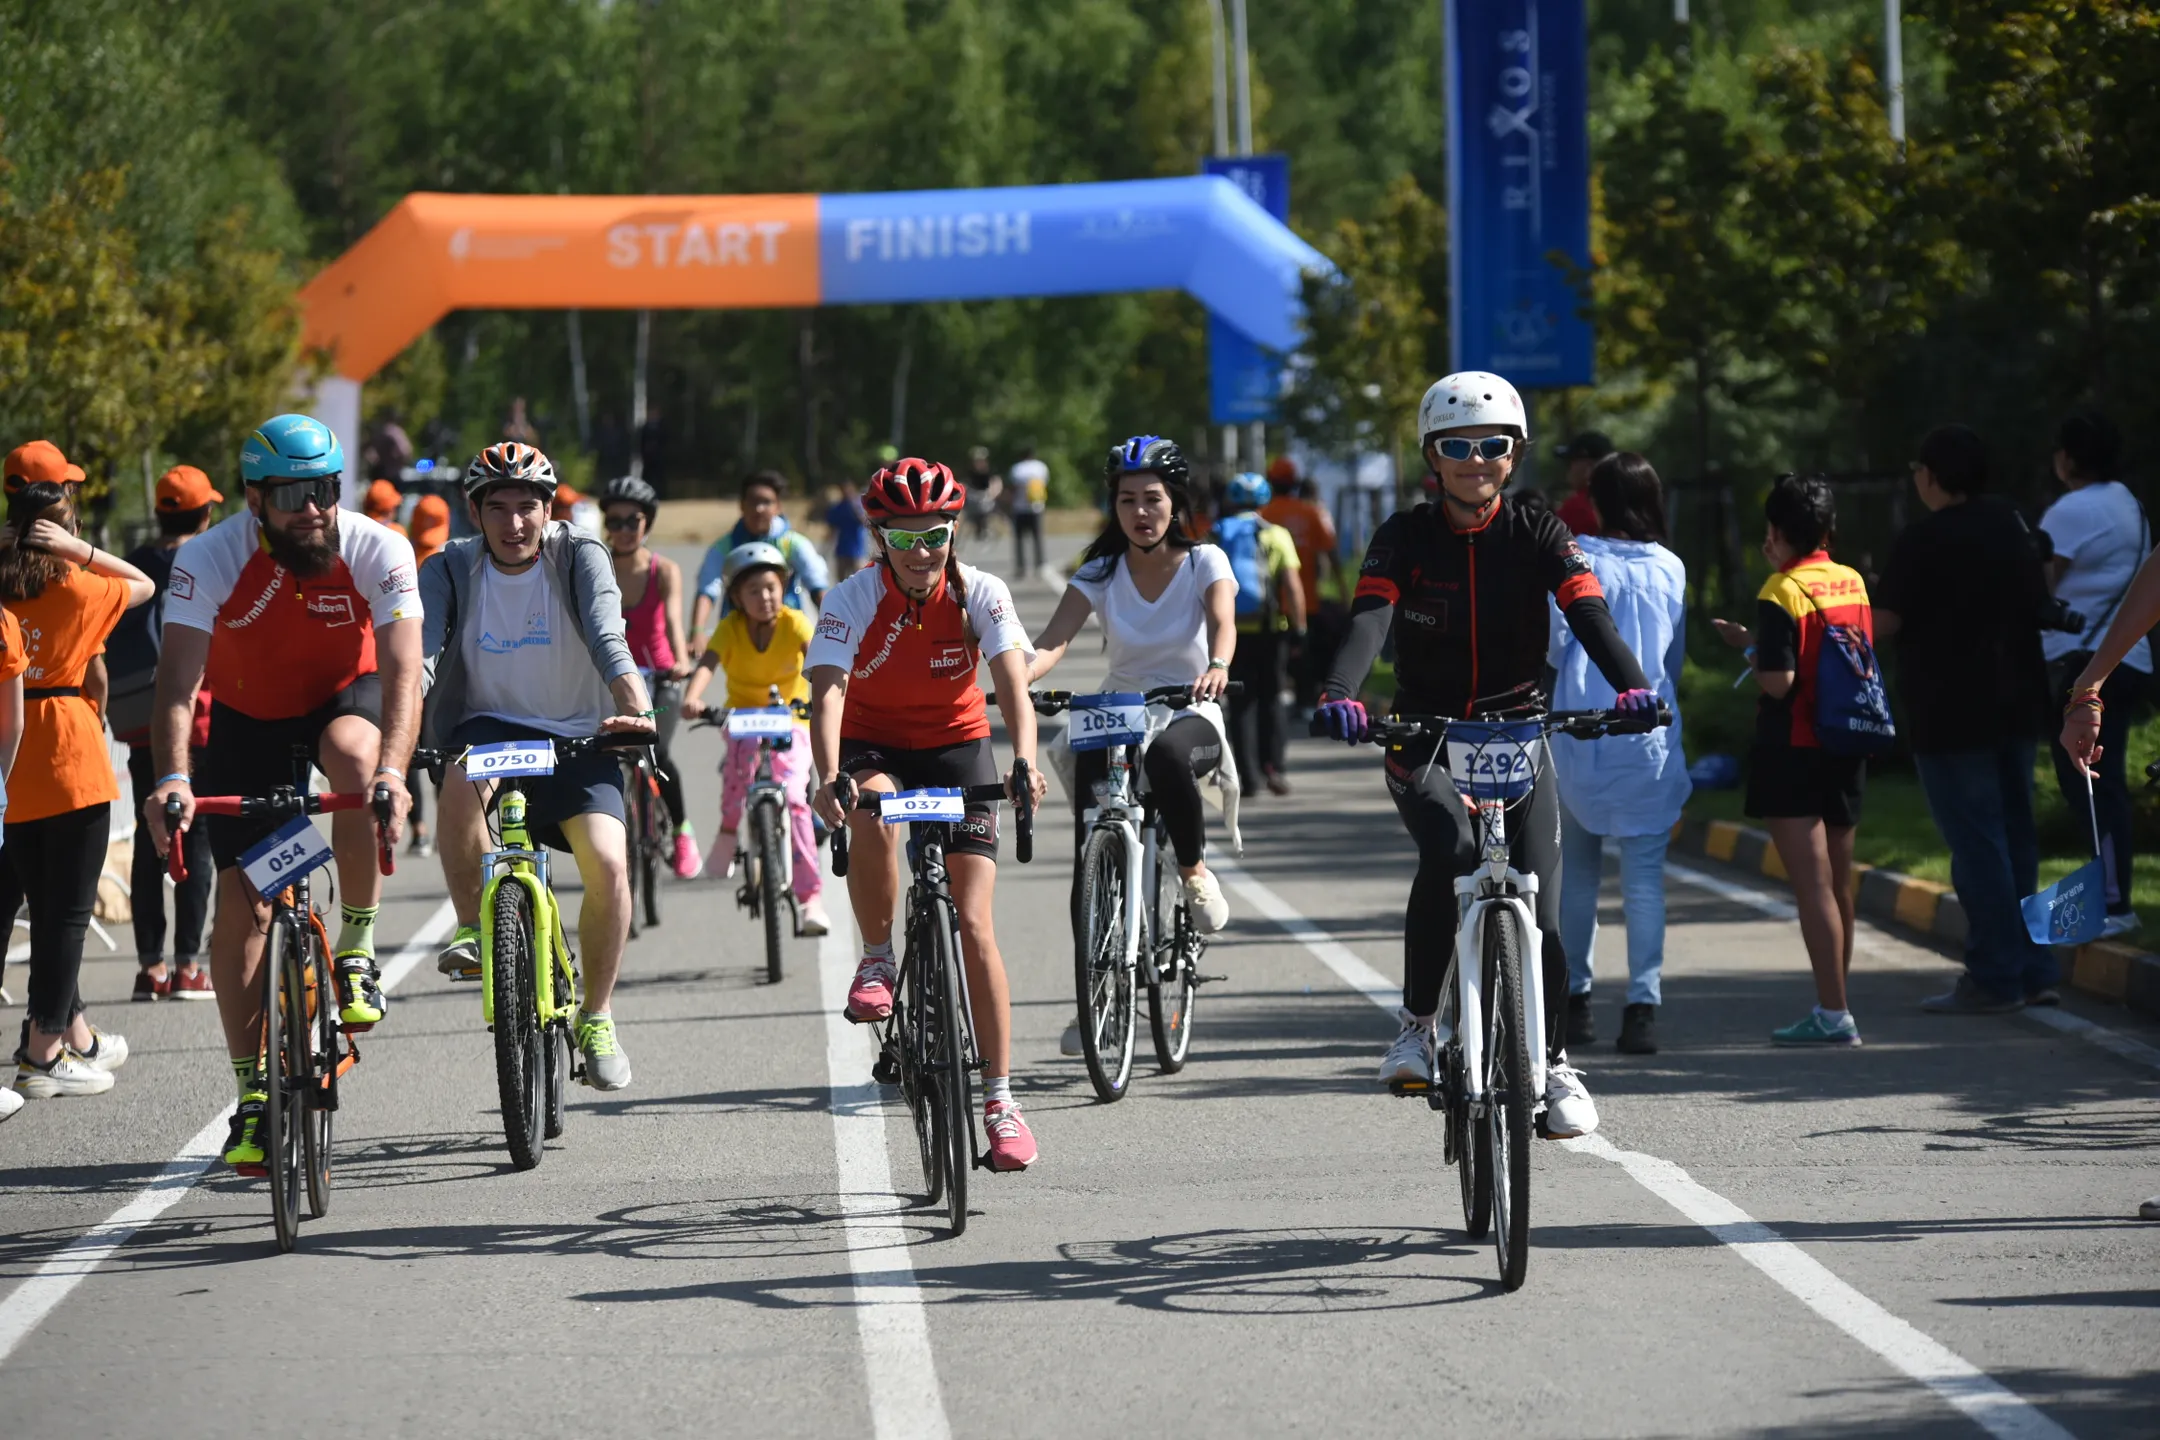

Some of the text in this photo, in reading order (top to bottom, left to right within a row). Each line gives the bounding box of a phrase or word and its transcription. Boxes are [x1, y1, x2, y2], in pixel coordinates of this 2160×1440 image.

[1492, 26, 1537, 210] RIXOS
[607, 223, 787, 267] START
[846, 212, 1031, 261] FINISH
[1808, 579, 1865, 597] DHL
[307, 600, 347, 613] inform
[817, 617, 846, 629] nform
[1404, 609, 1436, 625] БЮРО
[815, 625, 840, 636] ЮРО
[1083, 712, 1126, 732] 1051
[483, 753, 538, 768] 0750
[1464, 752, 1527, 775] 1292
[904, 800, 942, 810] 037
[268, 841, 306, 872] 054
